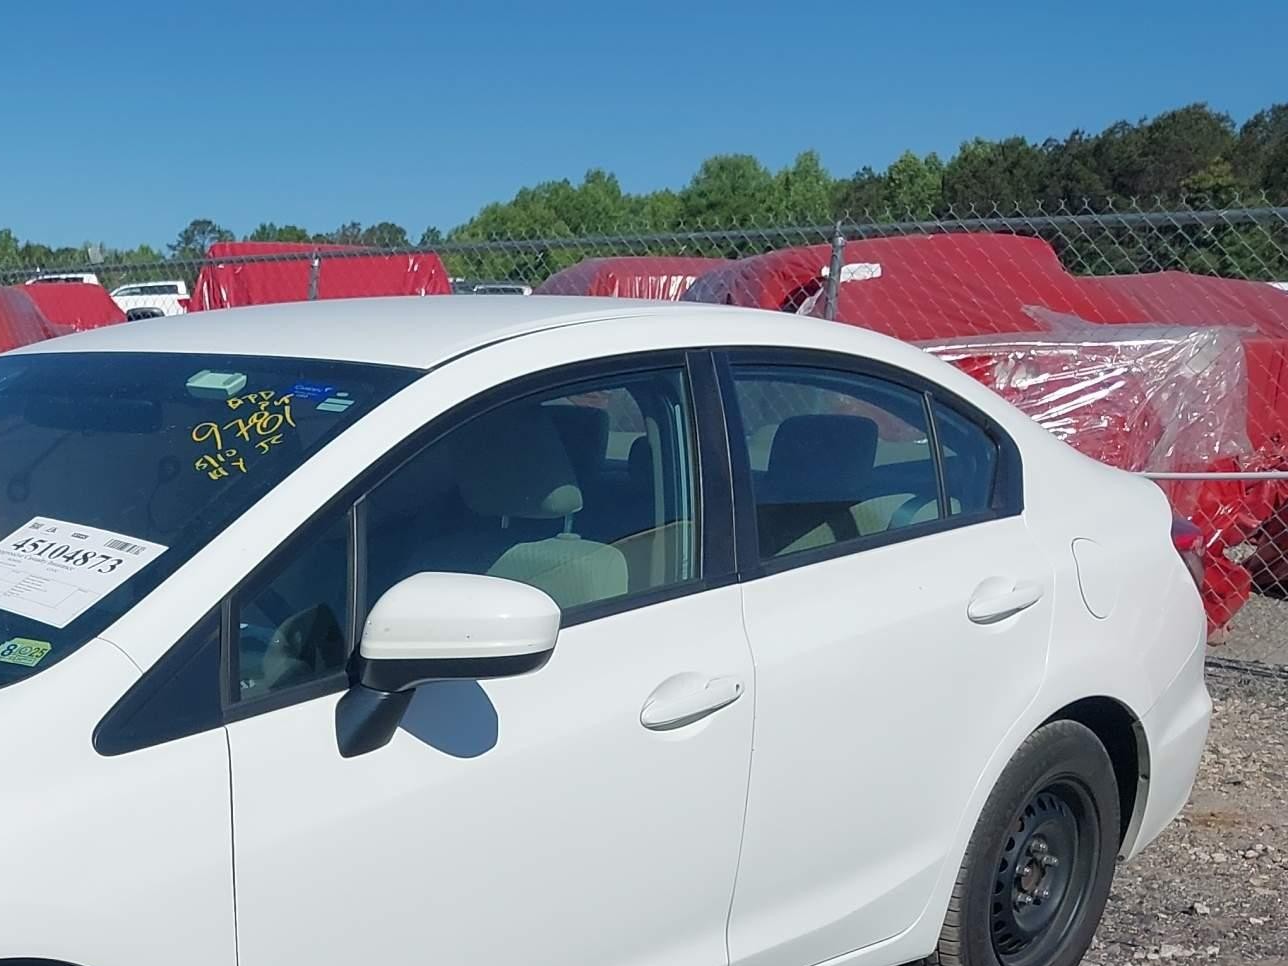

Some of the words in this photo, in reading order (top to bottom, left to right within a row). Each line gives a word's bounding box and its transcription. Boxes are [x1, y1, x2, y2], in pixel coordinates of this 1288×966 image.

[12, 537, 124, 574] 45104873
[0, 643, 18, 657] 8
[28, 647, 48, 659] 25
